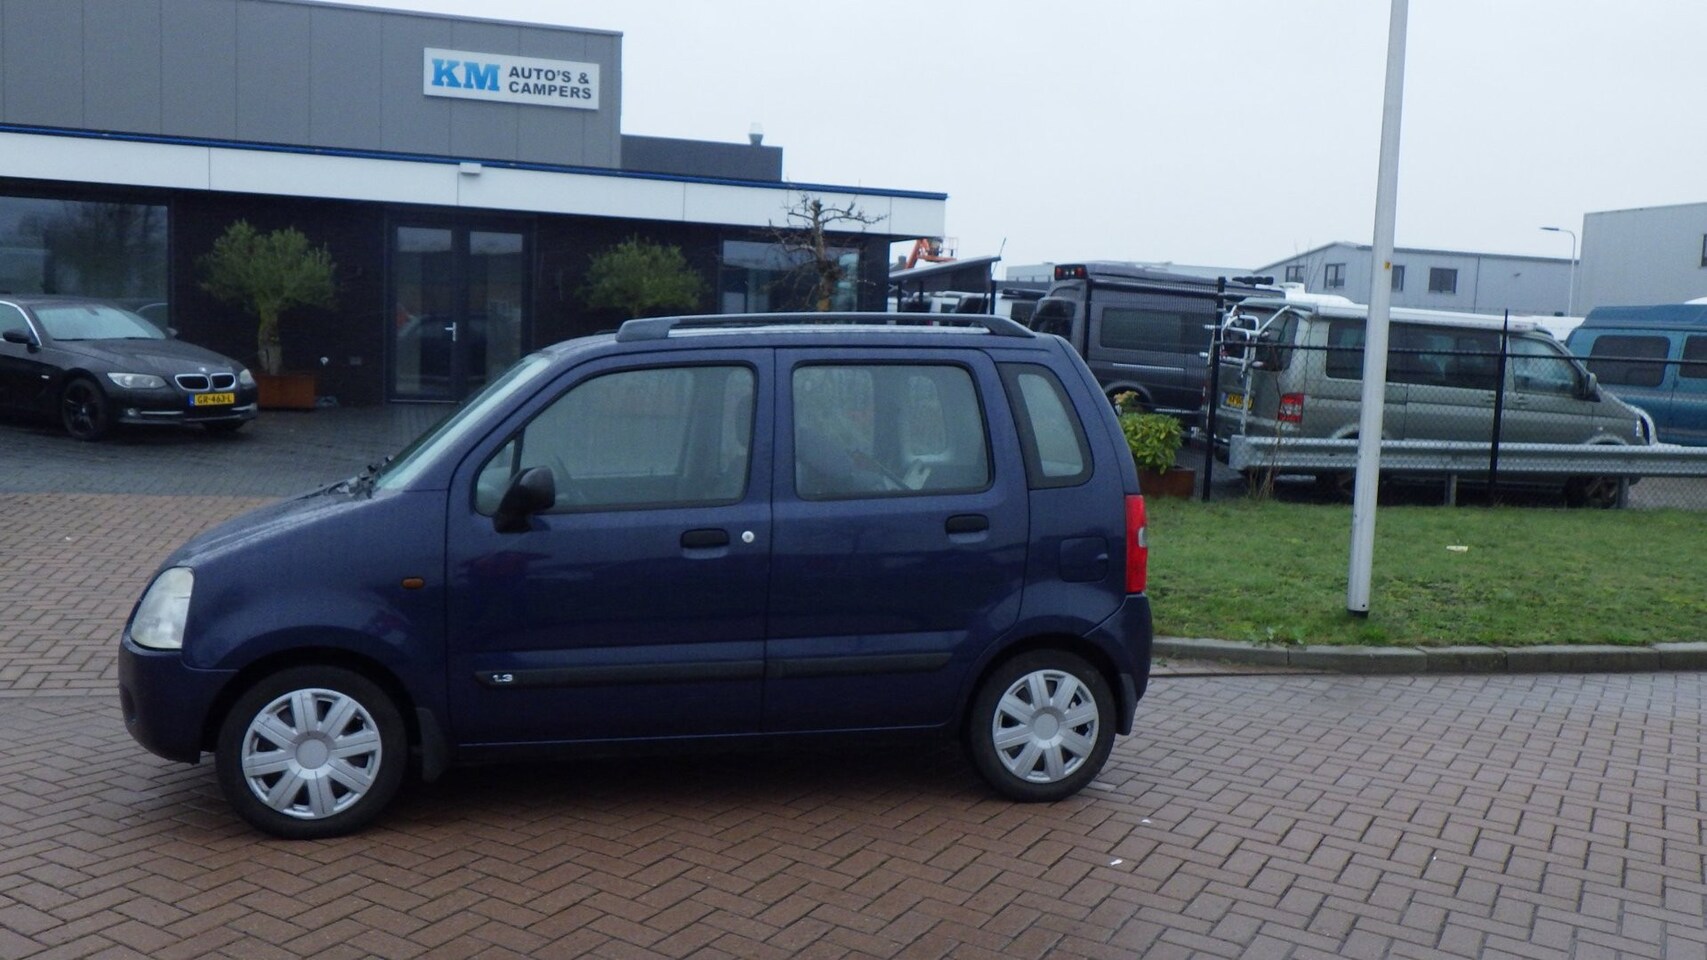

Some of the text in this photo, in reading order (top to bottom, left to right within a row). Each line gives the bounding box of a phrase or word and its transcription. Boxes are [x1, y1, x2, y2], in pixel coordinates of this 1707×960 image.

[431, 58, 501, 92] KM
[508, 66, 590, 85] AUTO'S &
[508, 81, 592, 100] CAMPERS
[492, 674, 513, 682] 1.3
